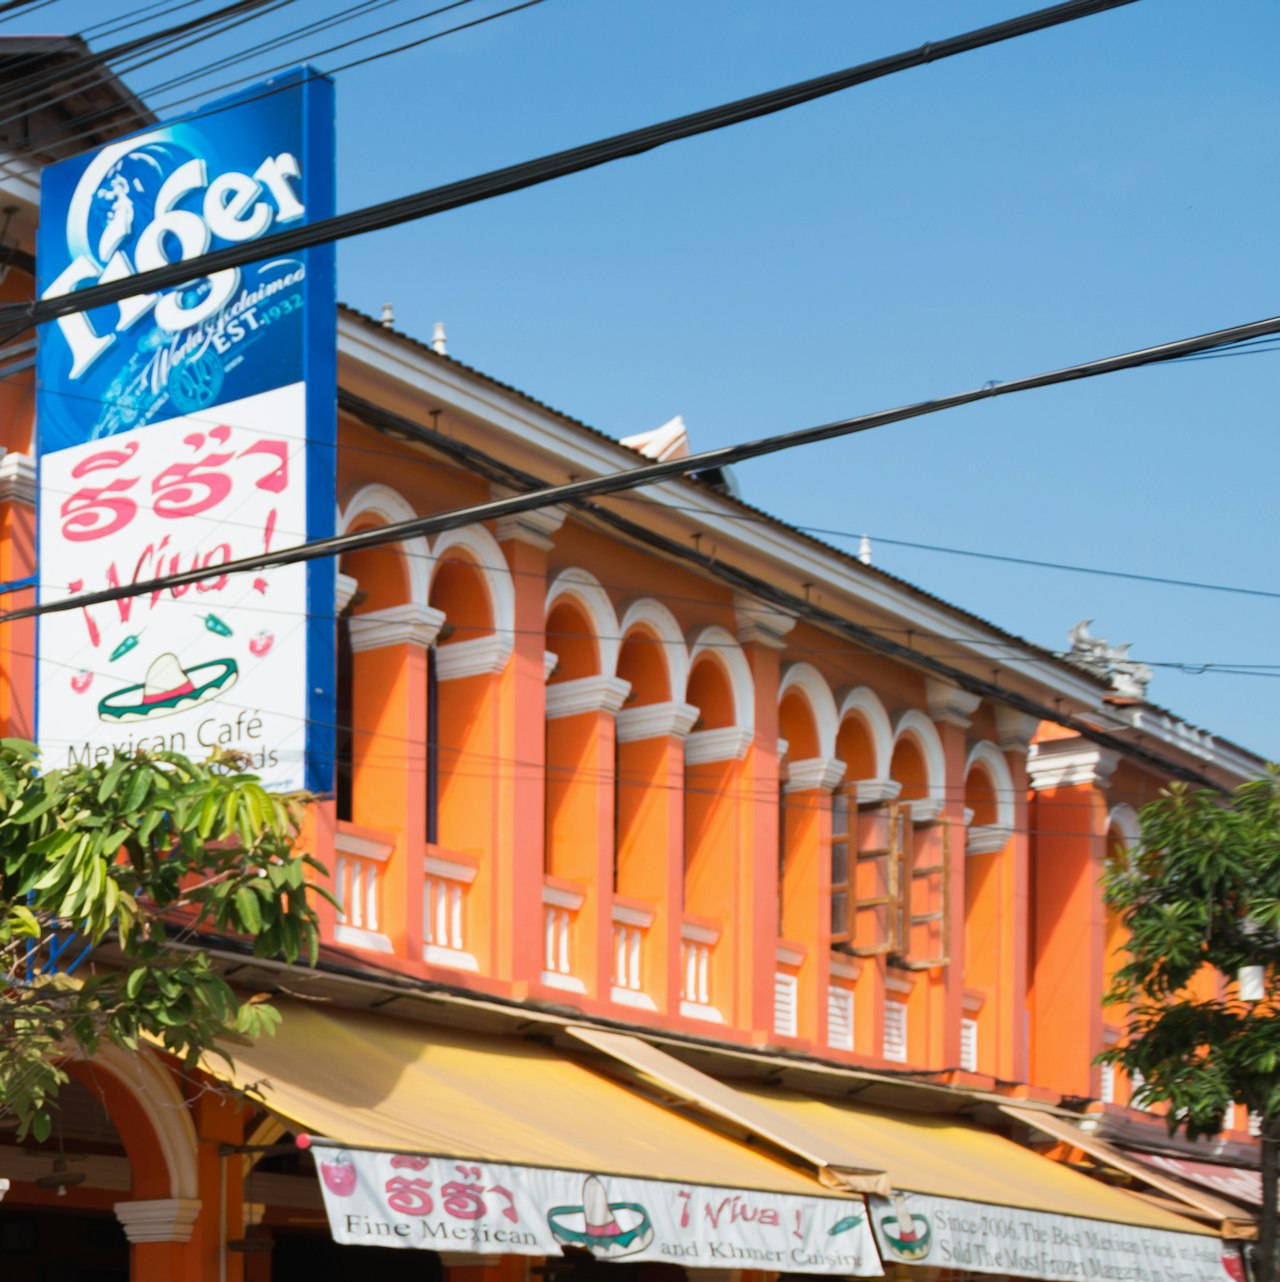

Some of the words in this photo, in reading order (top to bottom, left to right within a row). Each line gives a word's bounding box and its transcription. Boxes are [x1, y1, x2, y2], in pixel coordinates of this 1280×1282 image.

[197, 710, 263, 748] Café
[345, 1214, 411, 1237] Fine
[421, 1220, 538, 1245] Mexican
[935, 1211, 977, 1235] Since
[660, 1240, 697, 1258] and
[710, 1241, 782, 1262] Khmer
